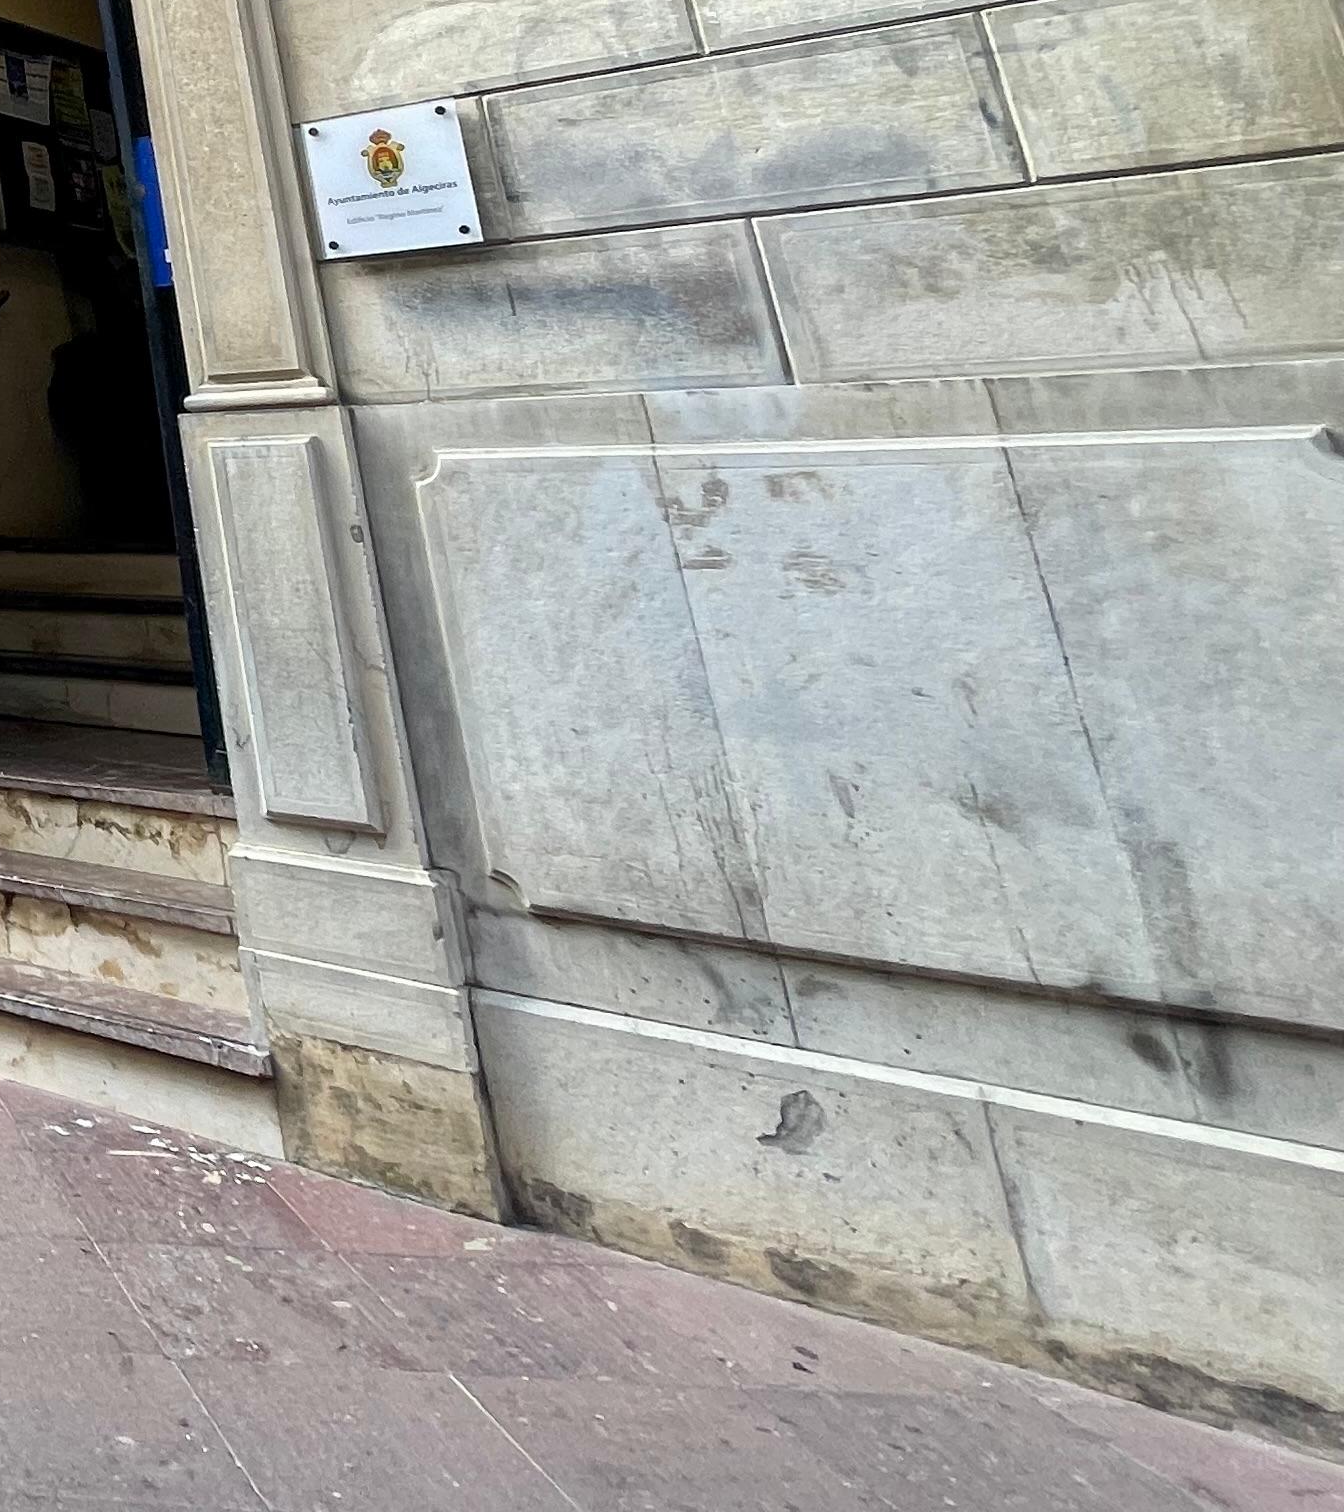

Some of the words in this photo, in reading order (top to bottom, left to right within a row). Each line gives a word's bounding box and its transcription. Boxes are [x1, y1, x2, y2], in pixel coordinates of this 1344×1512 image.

[327, 190, 395, 207] Ayuntamiento
[397, 187, 410, 196] de
[411, 180, 458, 194] Algeciras
